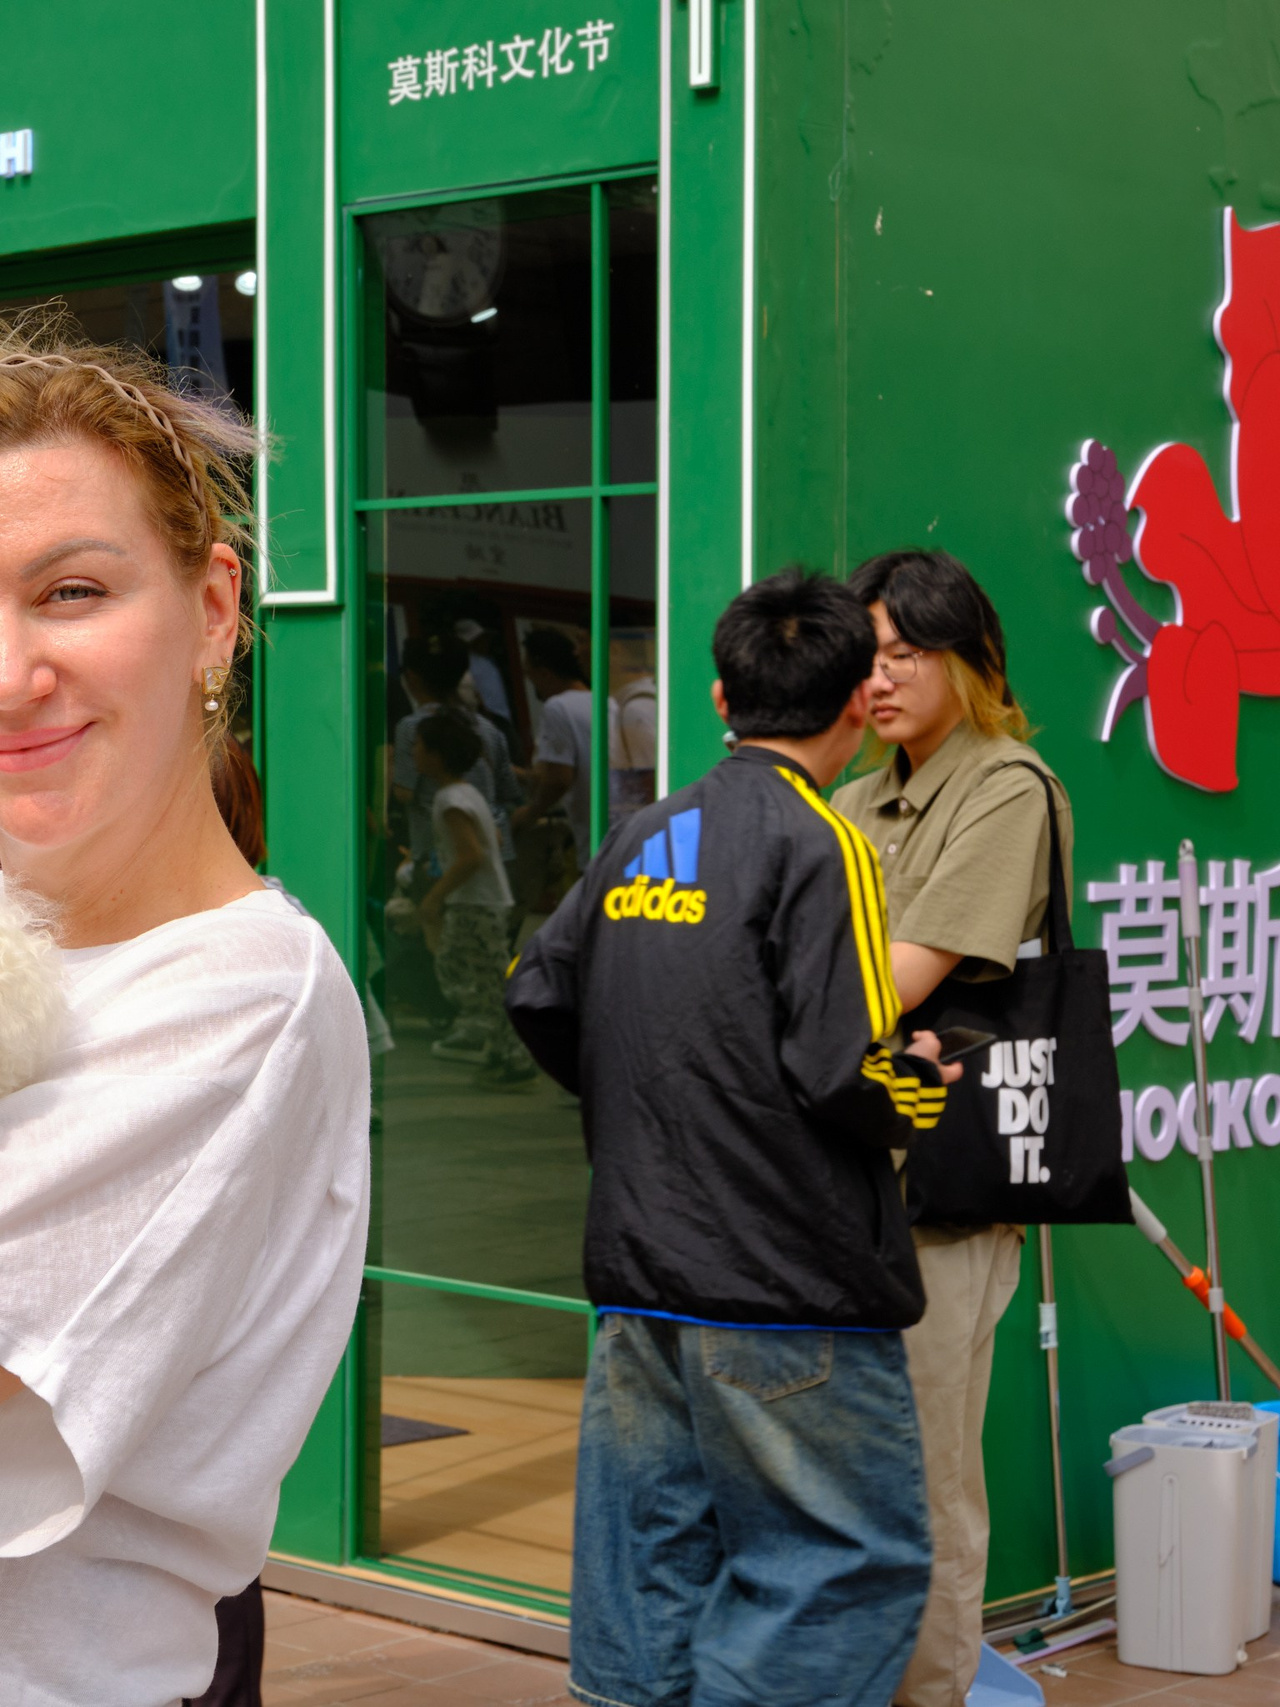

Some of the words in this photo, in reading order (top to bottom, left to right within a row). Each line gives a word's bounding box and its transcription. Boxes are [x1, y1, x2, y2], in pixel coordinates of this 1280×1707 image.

[387, 19, 614, 106] 莫斯科文化节
[603, 873, 707, 924] adidas
[981, 1037, 1057, 1089] JUST
[998, 1086, 1049, 1135] DO
[1009, 1135, 1051, 1184] IT.
